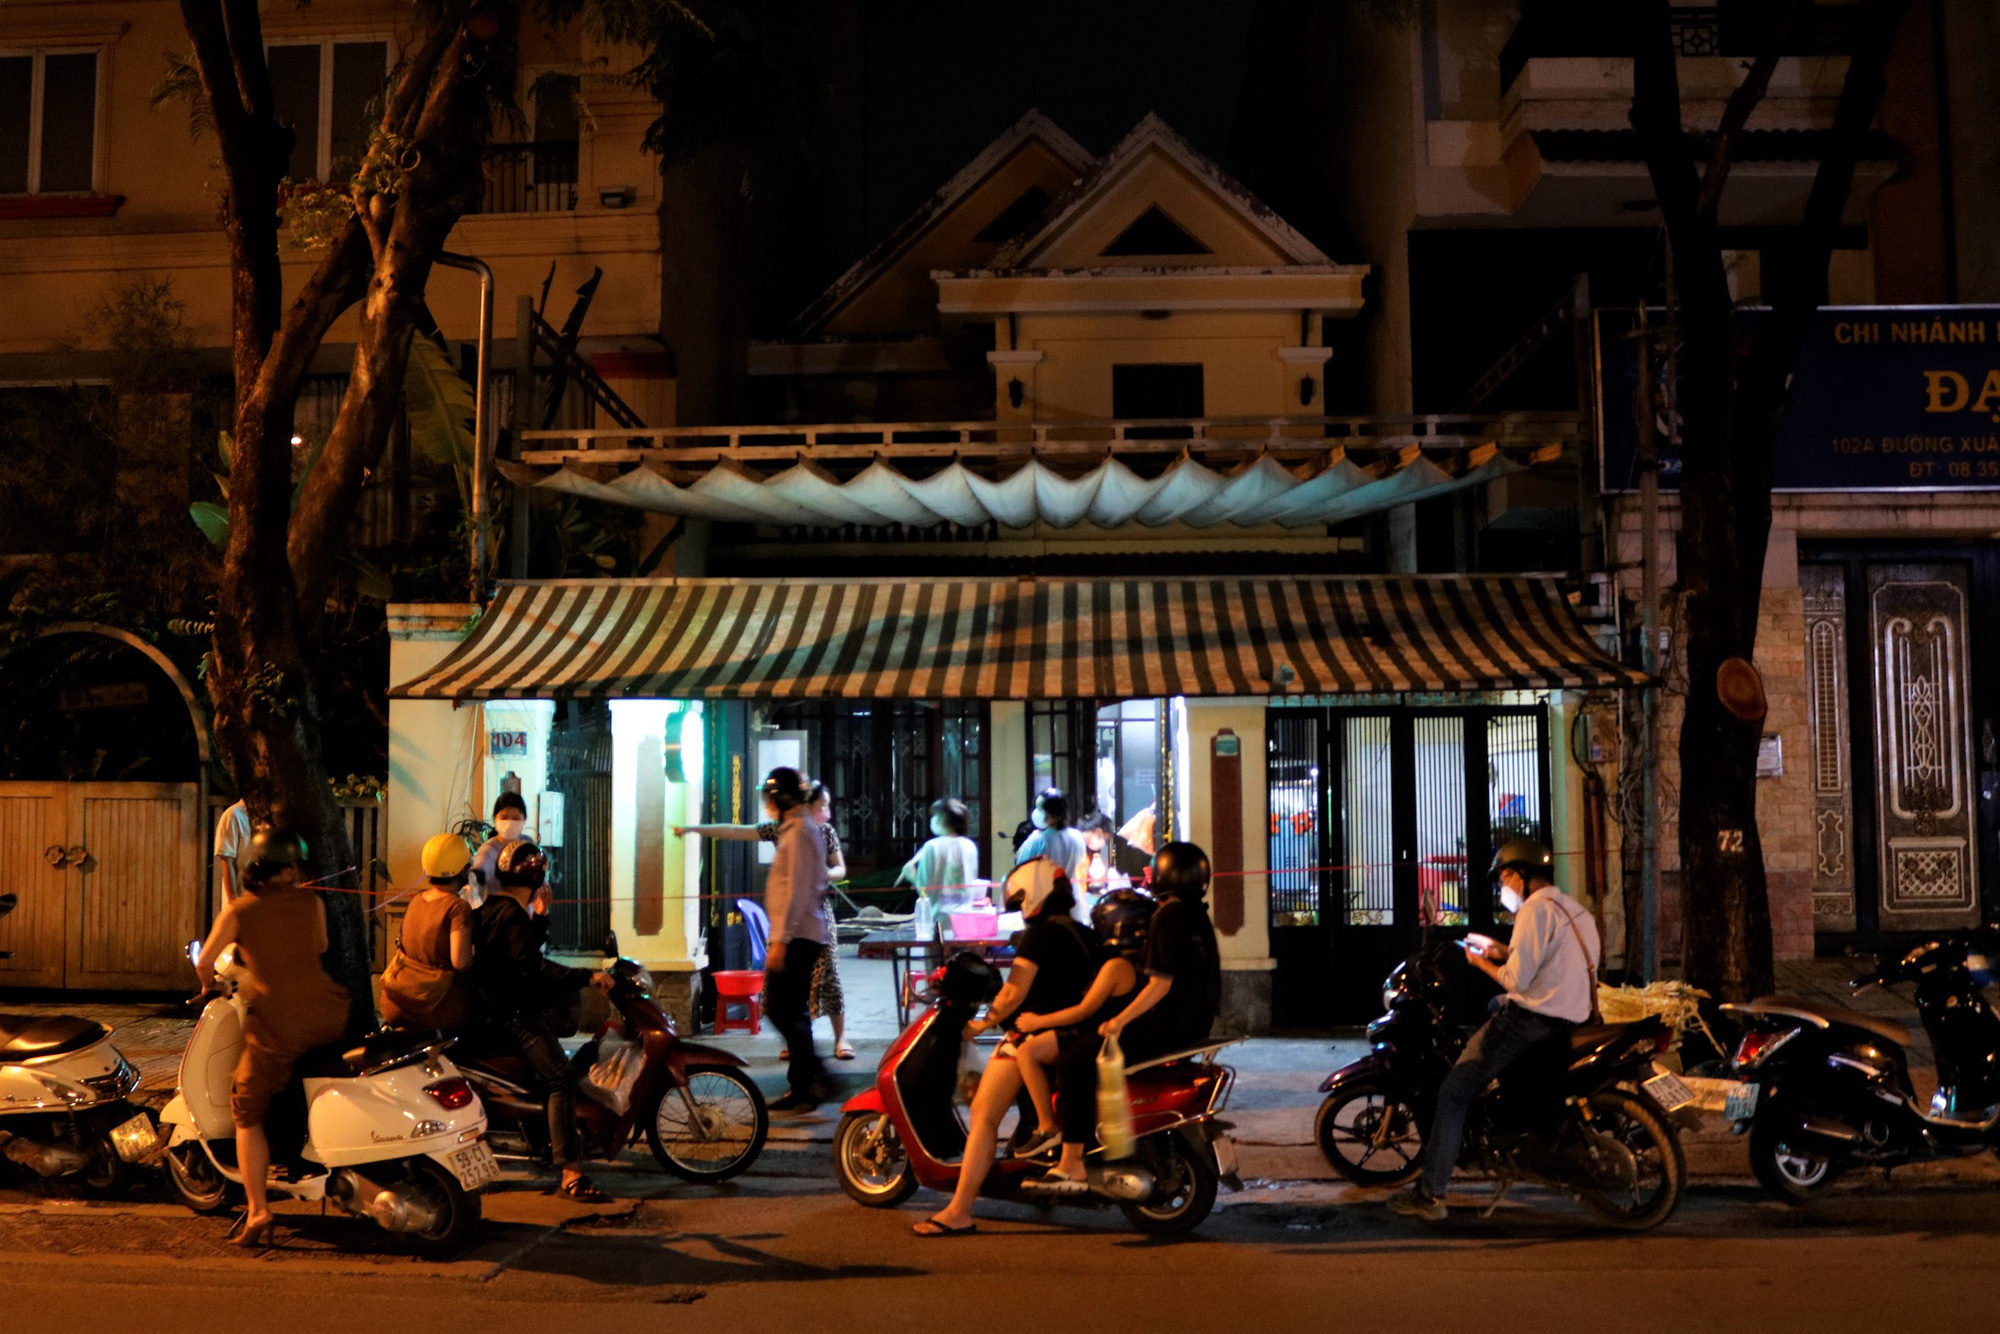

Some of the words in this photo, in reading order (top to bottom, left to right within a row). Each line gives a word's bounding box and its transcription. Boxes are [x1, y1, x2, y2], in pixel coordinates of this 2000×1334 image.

[1833, 321, 1881, 344] CHI
[1890, 314, 1986, 344] NHÁNH
[1831, 436, 1876, 454] 102A
[493, 732, 526, 748] 104
[1717, 829, 1744, 853] 72
